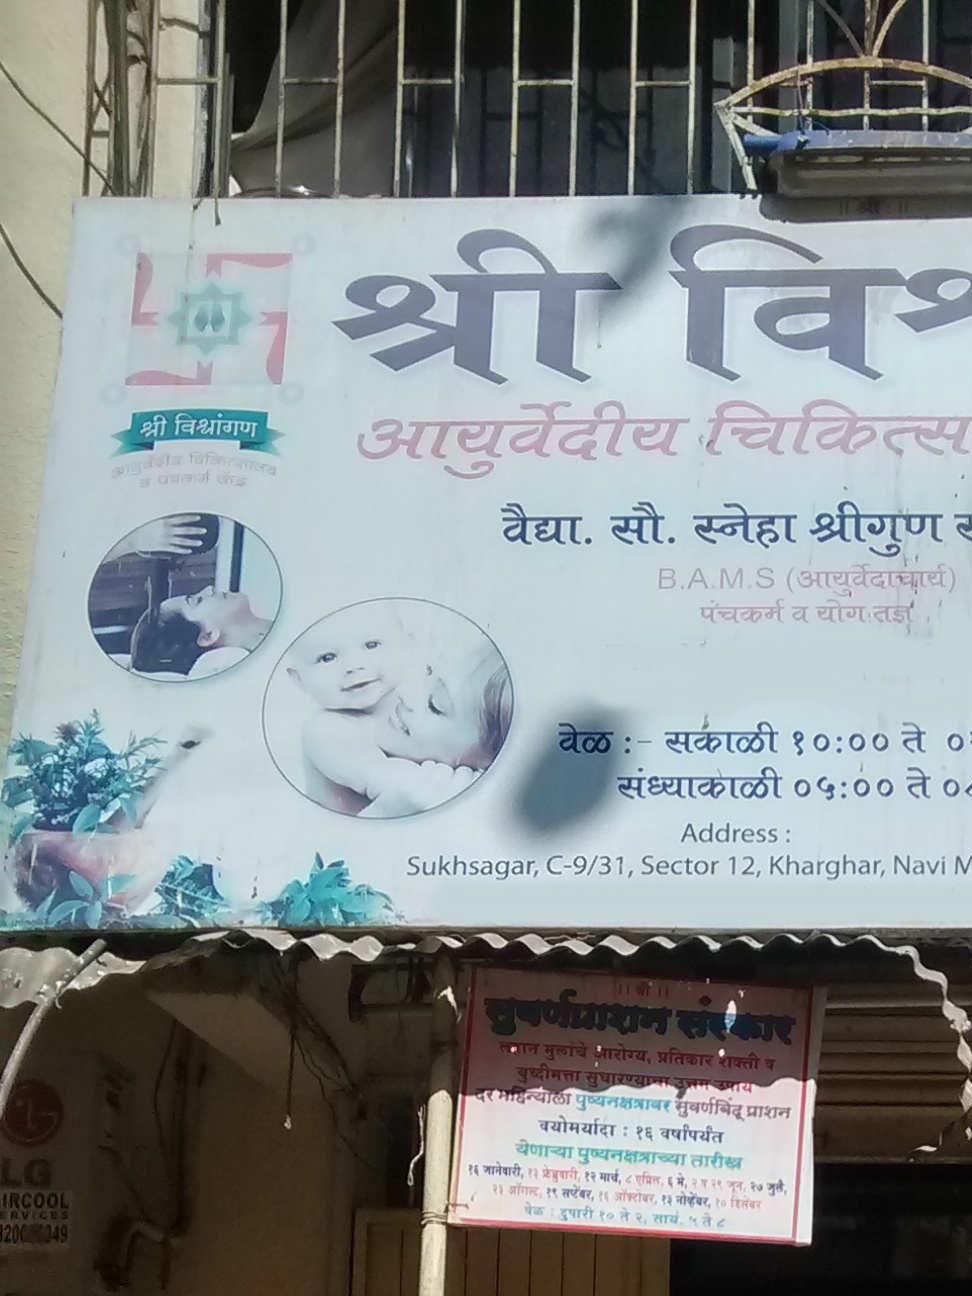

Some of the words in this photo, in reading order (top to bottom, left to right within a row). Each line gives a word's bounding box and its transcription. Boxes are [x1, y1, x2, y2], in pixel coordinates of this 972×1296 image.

[330, 227, 623, 386] श्री
[140, 414, 167, 437] श्री
[357, 400, 690, 480] आयुर्वेदीय
[501, 502, 593, 545] वैद्या.
[610, 501, 676, 545] सौ.
[693, 502, 798, 549] स्नेहा
[808, 501, 943, 558] श्रीगुण
[658, 567, 775, 590] B.A.M.S
[700, 599, 784, 624] पंचकर्म
[559, 723, 614, 755] वेळ
[664, 723, 778, 755] सकाळी
[793, 730, 890, 757] १०:००
[899, 723, 926, 755] ते
[616, 768, 783, 800] संध्याकाळी
[794, 776, 894, 801] ०५:००
[906, 768, 931, 800] ते
[681, 823, 779, 844] Address
[407, 855, 539, 879] Sukhsagar,
[546, 856, 634, 879] C-9/31,
[641, 856, 723, 876] Sector
[728, 857, 762, 879] 12,
[769, 855, 888, 879] Kharghar,
[892, 855, 946, 876] Navi
[657, 1047, 715, 1067] प्रतिकार
[747, 1104, 791, 1119] प्राशन
[539, 1115, 616, 1138] वयोमर्यादा
[636, 1126, 653, 1141] १६
[2, 1192, 69, 1209] IRCOOL
